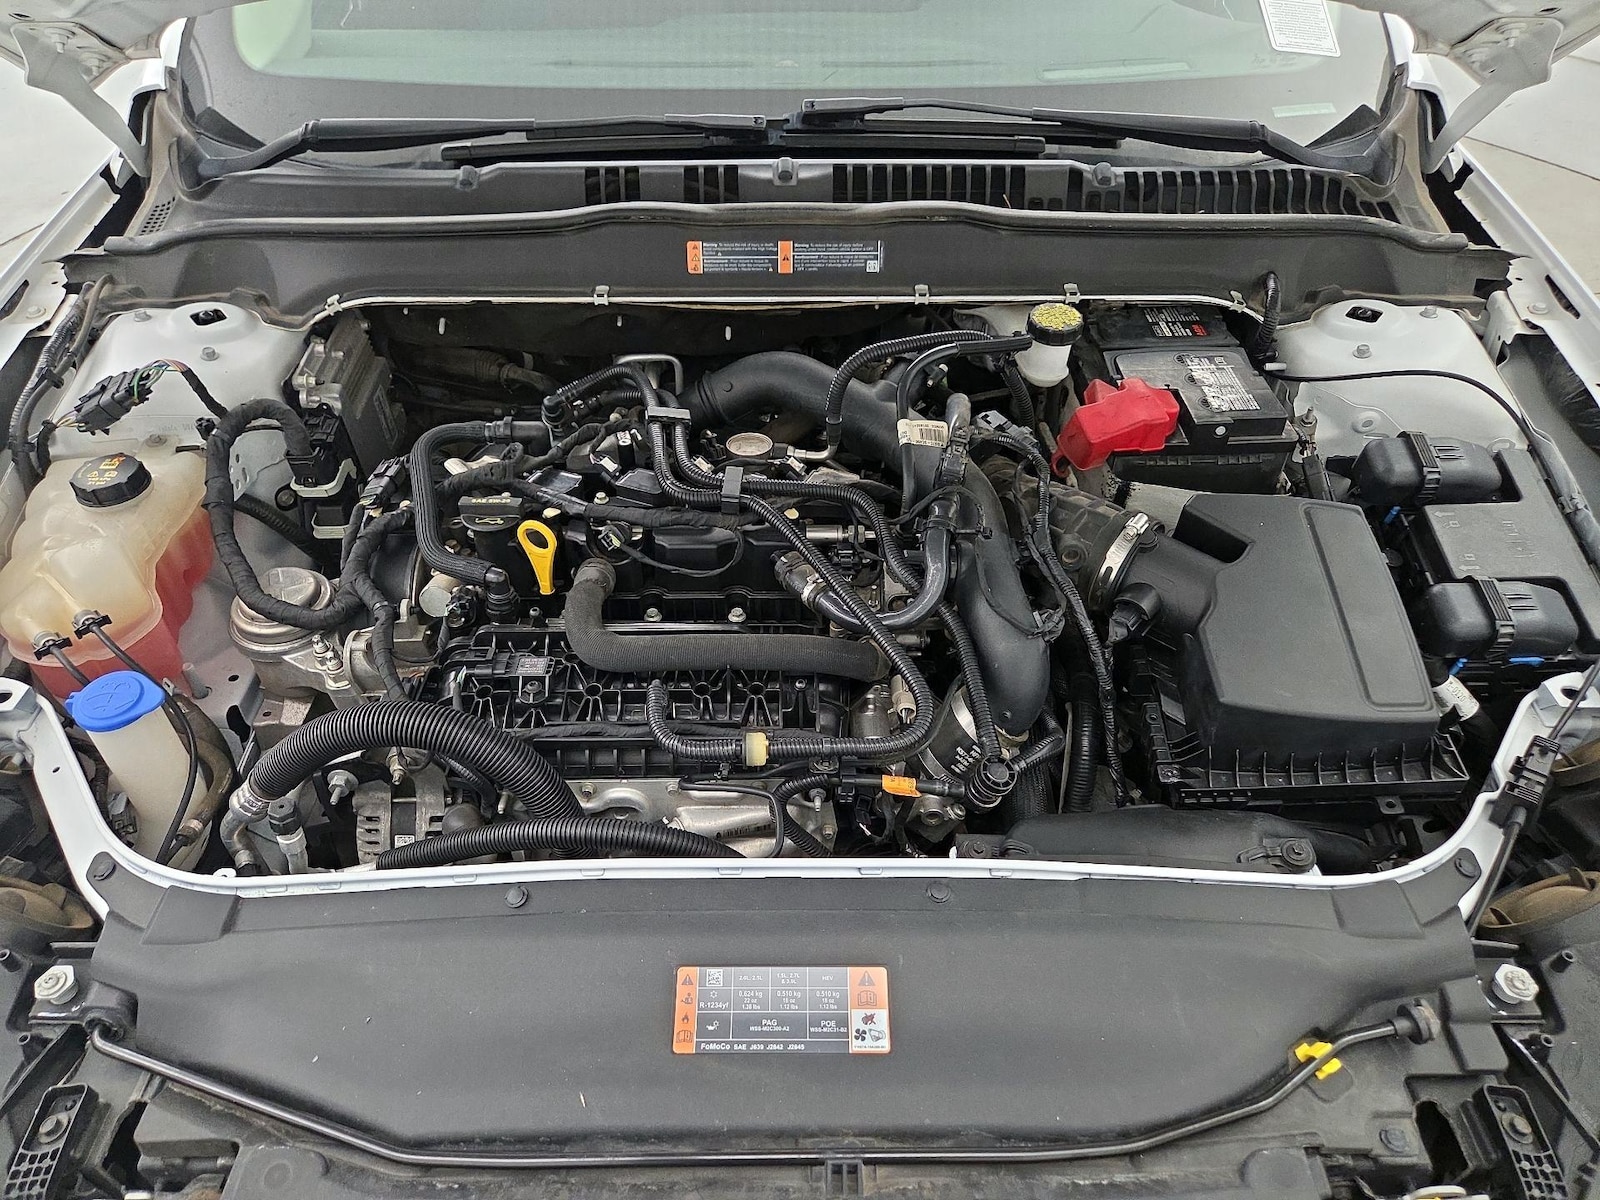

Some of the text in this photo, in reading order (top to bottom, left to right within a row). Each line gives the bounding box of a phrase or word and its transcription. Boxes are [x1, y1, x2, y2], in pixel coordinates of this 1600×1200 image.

[755, 990, 763, 998] kg
[793, 990, 801, 998] kg
[832, 990, 840, 998] kg
[700, 1001, 729, 1010] R-1234yf
[700, 1042, 731, 1050] FoMoCo
